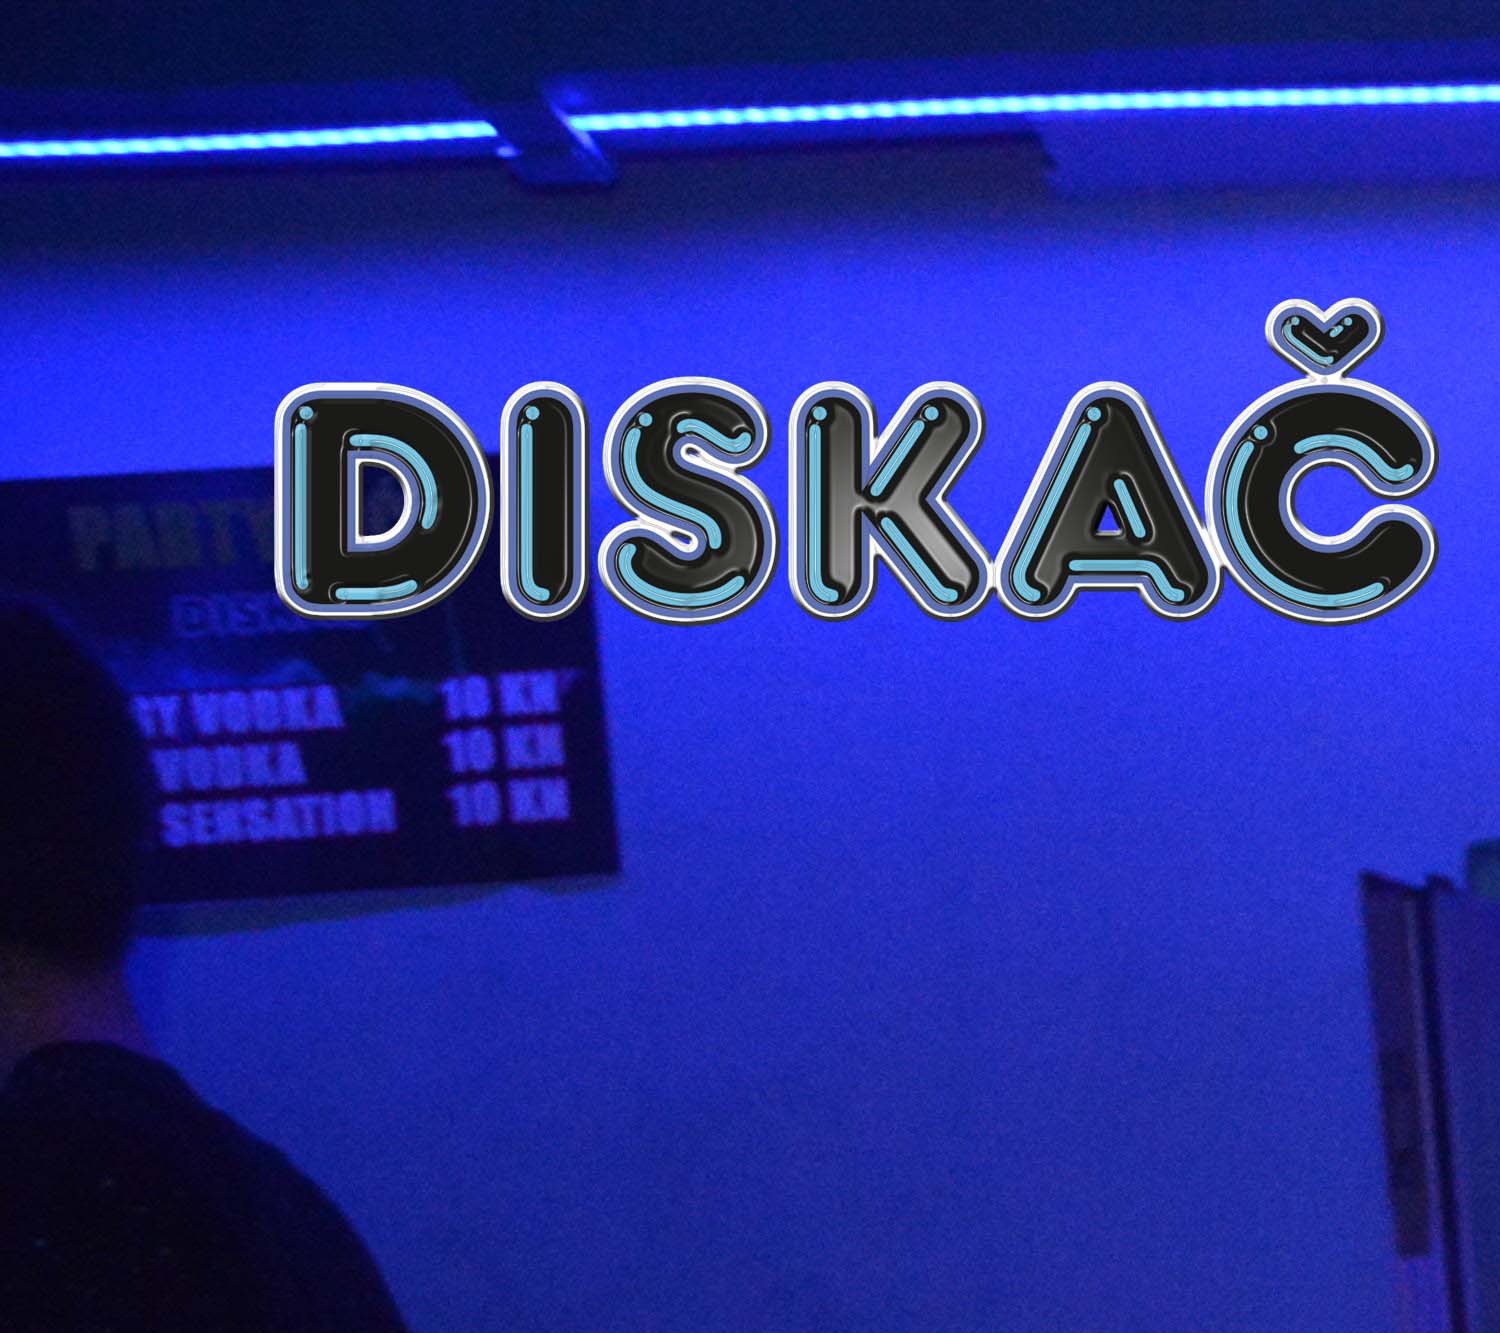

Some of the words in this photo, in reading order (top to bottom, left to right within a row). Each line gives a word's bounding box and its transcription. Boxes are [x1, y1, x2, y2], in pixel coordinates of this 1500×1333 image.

[191, 687, 345, 733] VODKA
[440, 676, 490, 719] 10
[152, 743, 308, 791] VODKA
[443, 729, 496, 772] 10
[505, 724, 565, 768] KN
[162, 790, 397, 846] SENSATION
[448, 781, 501, 826] 10
[510, 778, 571, 821] KN
